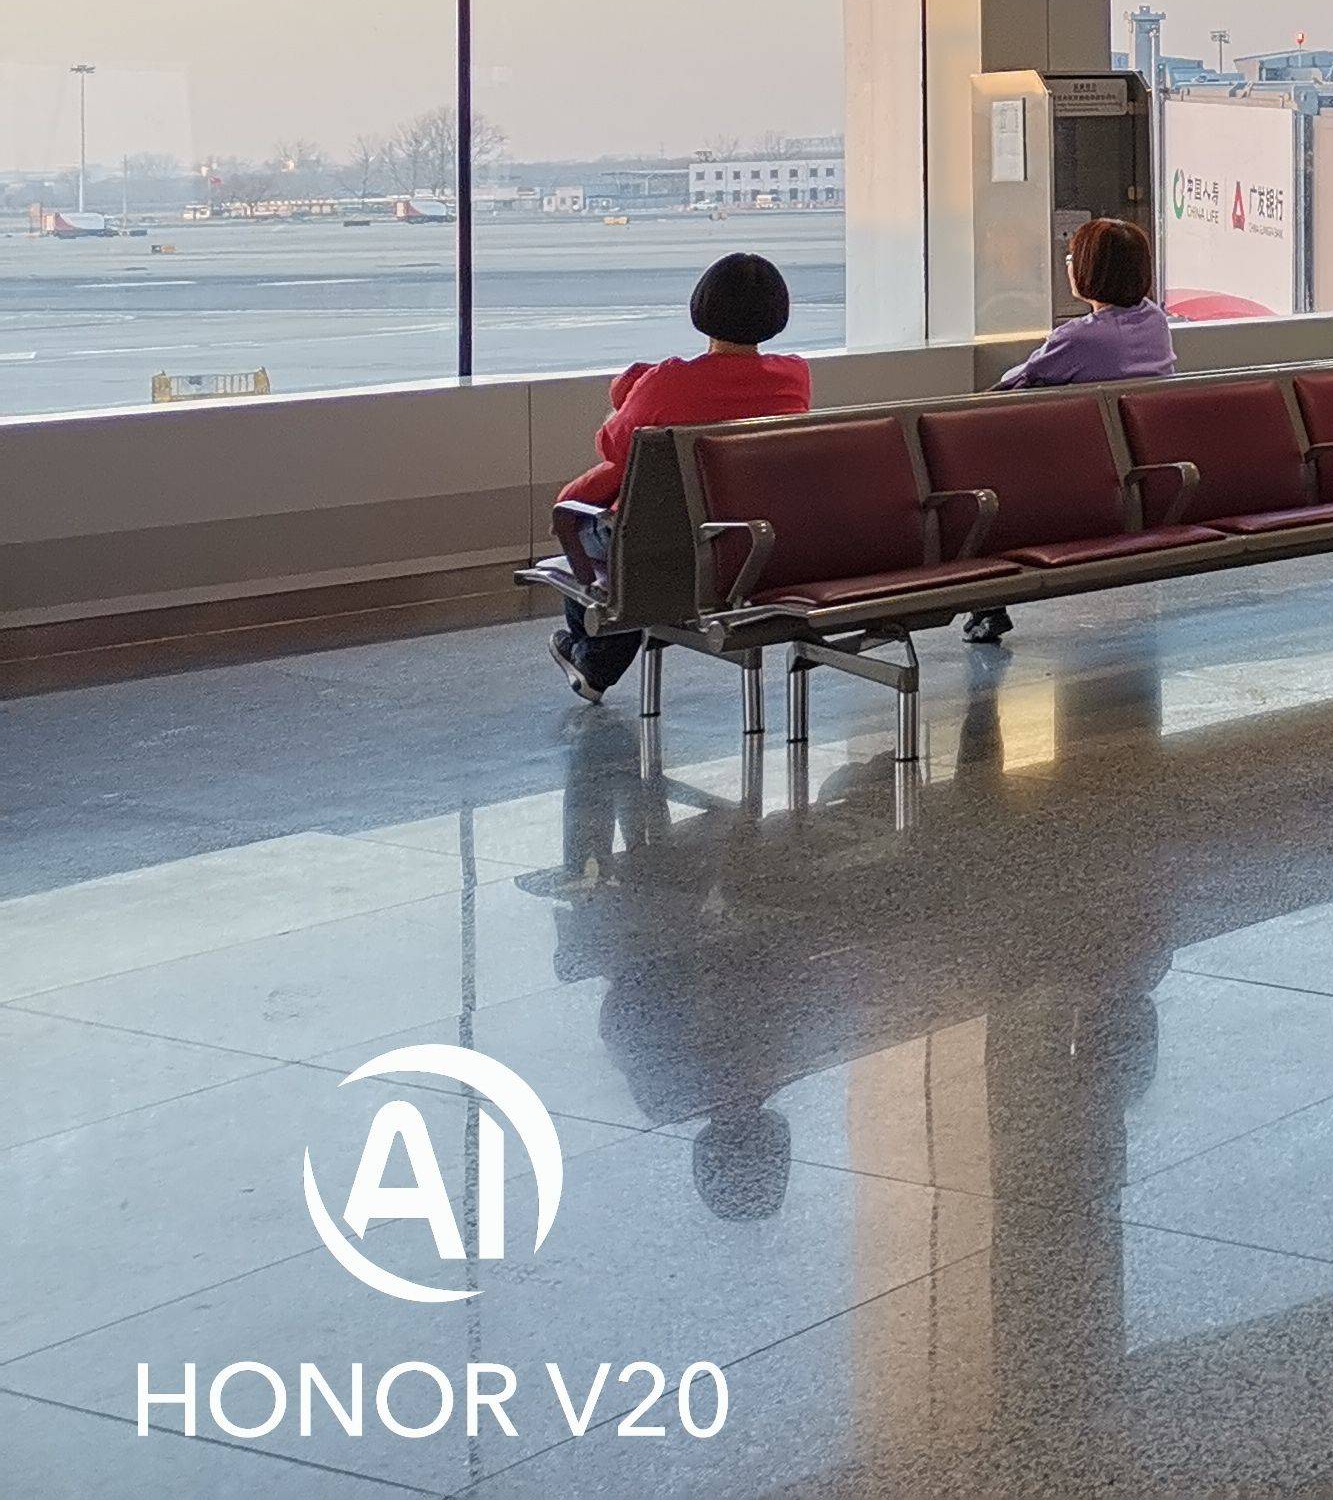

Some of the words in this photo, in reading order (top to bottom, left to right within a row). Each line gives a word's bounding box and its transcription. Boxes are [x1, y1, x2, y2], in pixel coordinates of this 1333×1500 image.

[1186, 174, 1220, 207] 中国人寿
[1249, 184, 1284, 222] 广发银行
[1186, 204, 1206, 220] CHINA
[1206, 208, 1220, 225] LIFE
